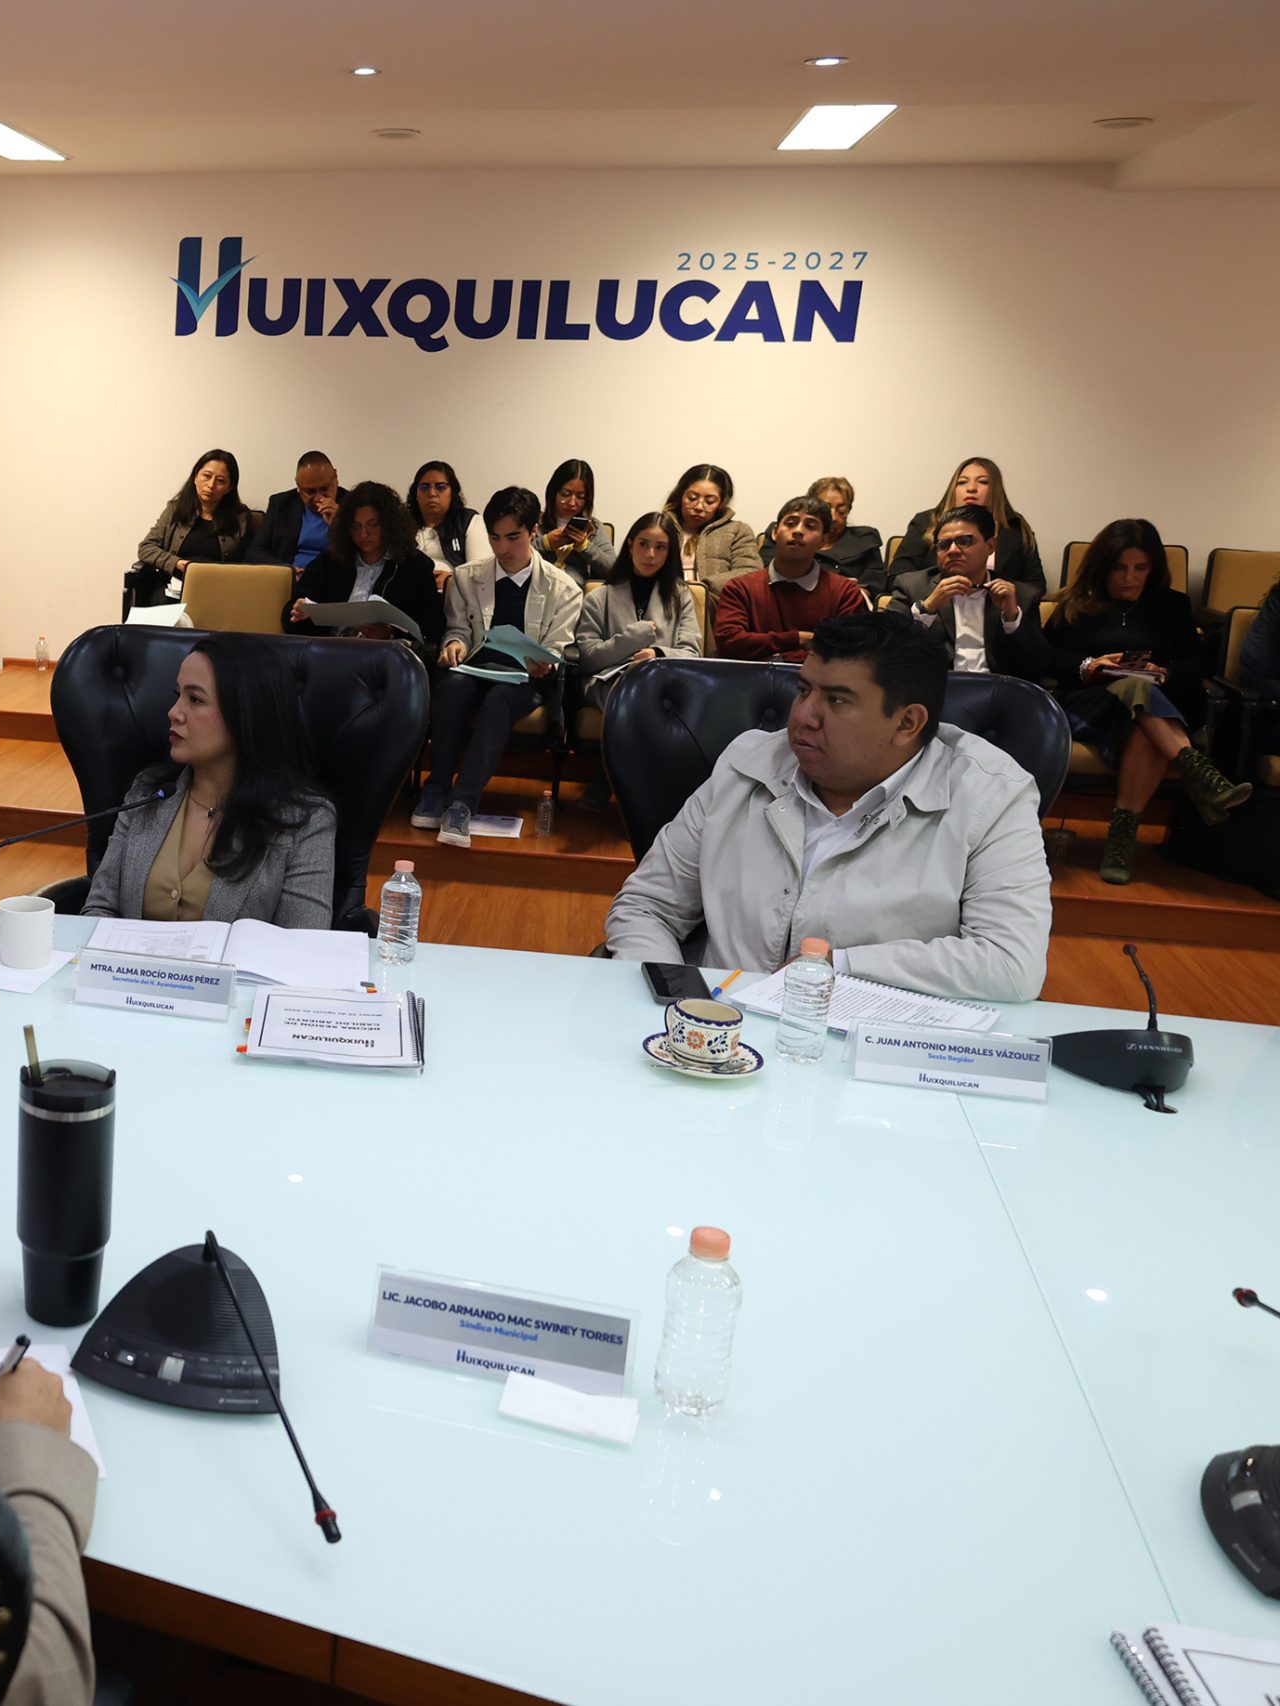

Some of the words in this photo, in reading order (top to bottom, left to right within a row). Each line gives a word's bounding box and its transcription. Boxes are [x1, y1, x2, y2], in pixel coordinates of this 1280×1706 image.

[677, 252, 869, 271] 2025-2027
[174, 237, 863, 353] HUIXQUILUCAN
[90, 963, 114, 973] MTRA.
[116, 966, 139, 977] ALMA
[140, 968, 166, 979] ROCÍO
[168, 972, 194, 982] ROJAS
[195, 974, 220, 986] PÉREZ
[865, 1035, 874, 1044] C.
[876, 1037, 901, 1047] JUAN
[902, 1041, 947, 1052] ANTONIO
[948, 1045, 993, 1057] MORALES
[995, 1048, 1041, 1062] VÁZQUEZ
[382, 1290, 402, 1302] LIC.
[404, 1294, 447, 1312] JACOBO
[449, 1303, 505, 1323] ARMANDO
[507, 1314, 532, 1329] MAC
[534, 1319, 579, 1337] SWINEY
[581, 1328, 623, 1345] TORRES
[459, 1319, 492, 1334] Síndico
[494, 1324, 538, 1343] Municipal
